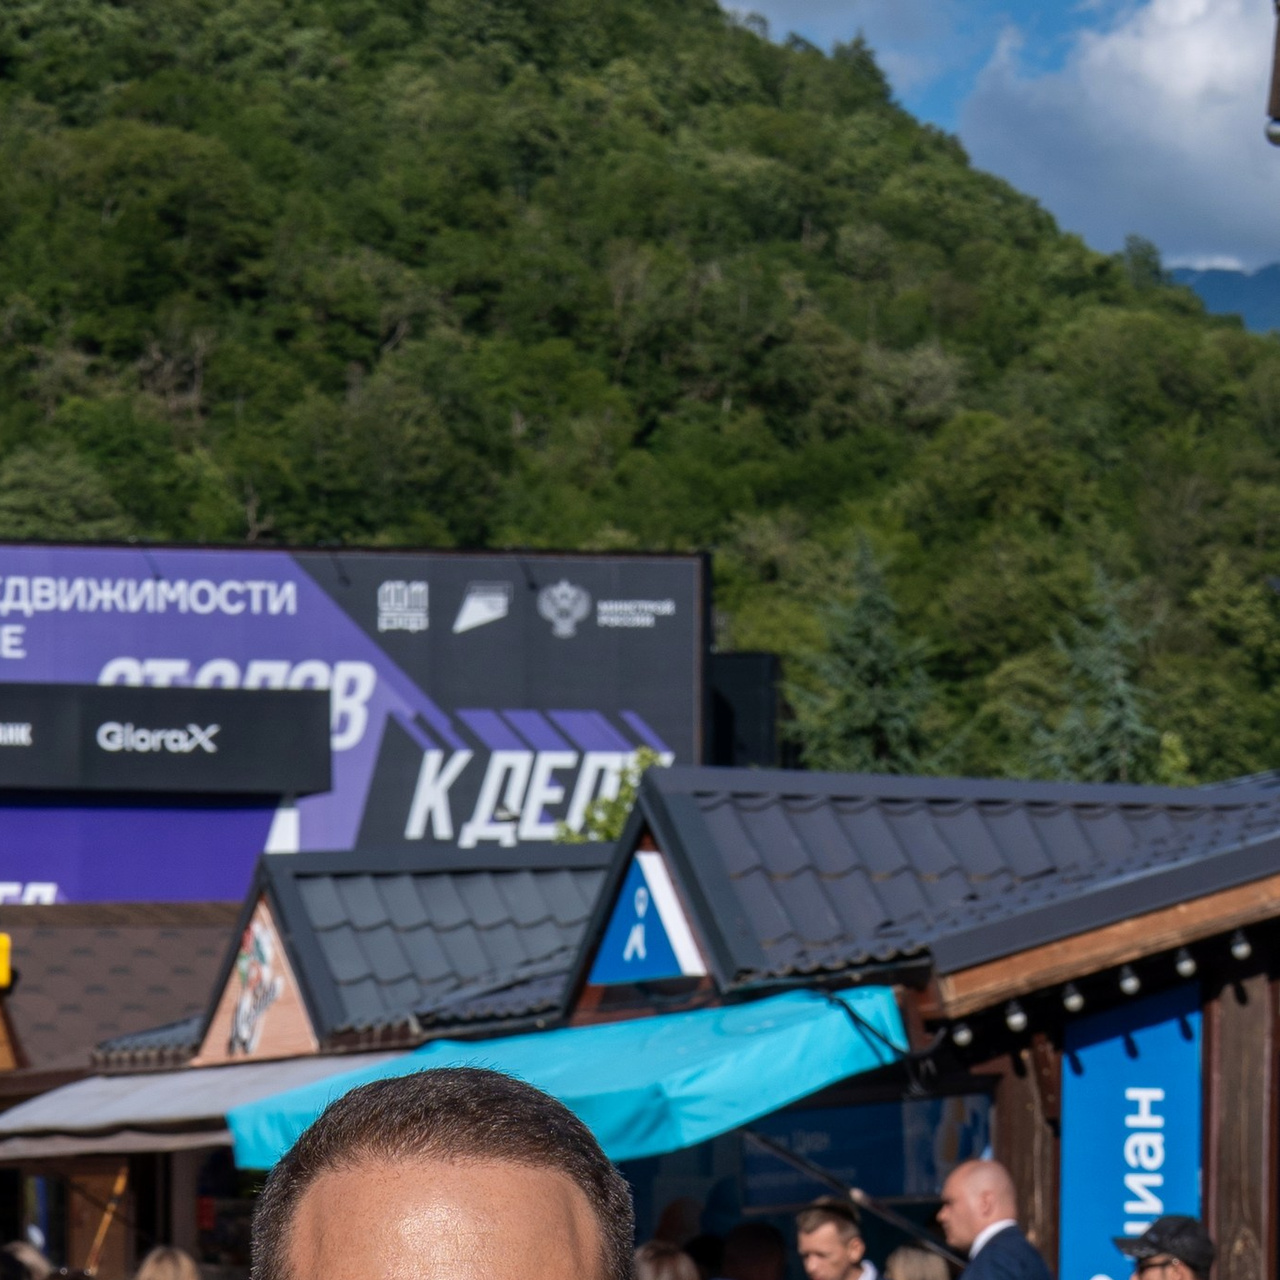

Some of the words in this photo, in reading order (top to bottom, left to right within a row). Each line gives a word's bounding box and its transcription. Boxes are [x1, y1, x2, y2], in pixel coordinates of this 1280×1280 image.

[96, 720, 220, 754] GloraX
[405, 749, 474, 841] К
[458, 749, 675, 849] ДЕЛ
